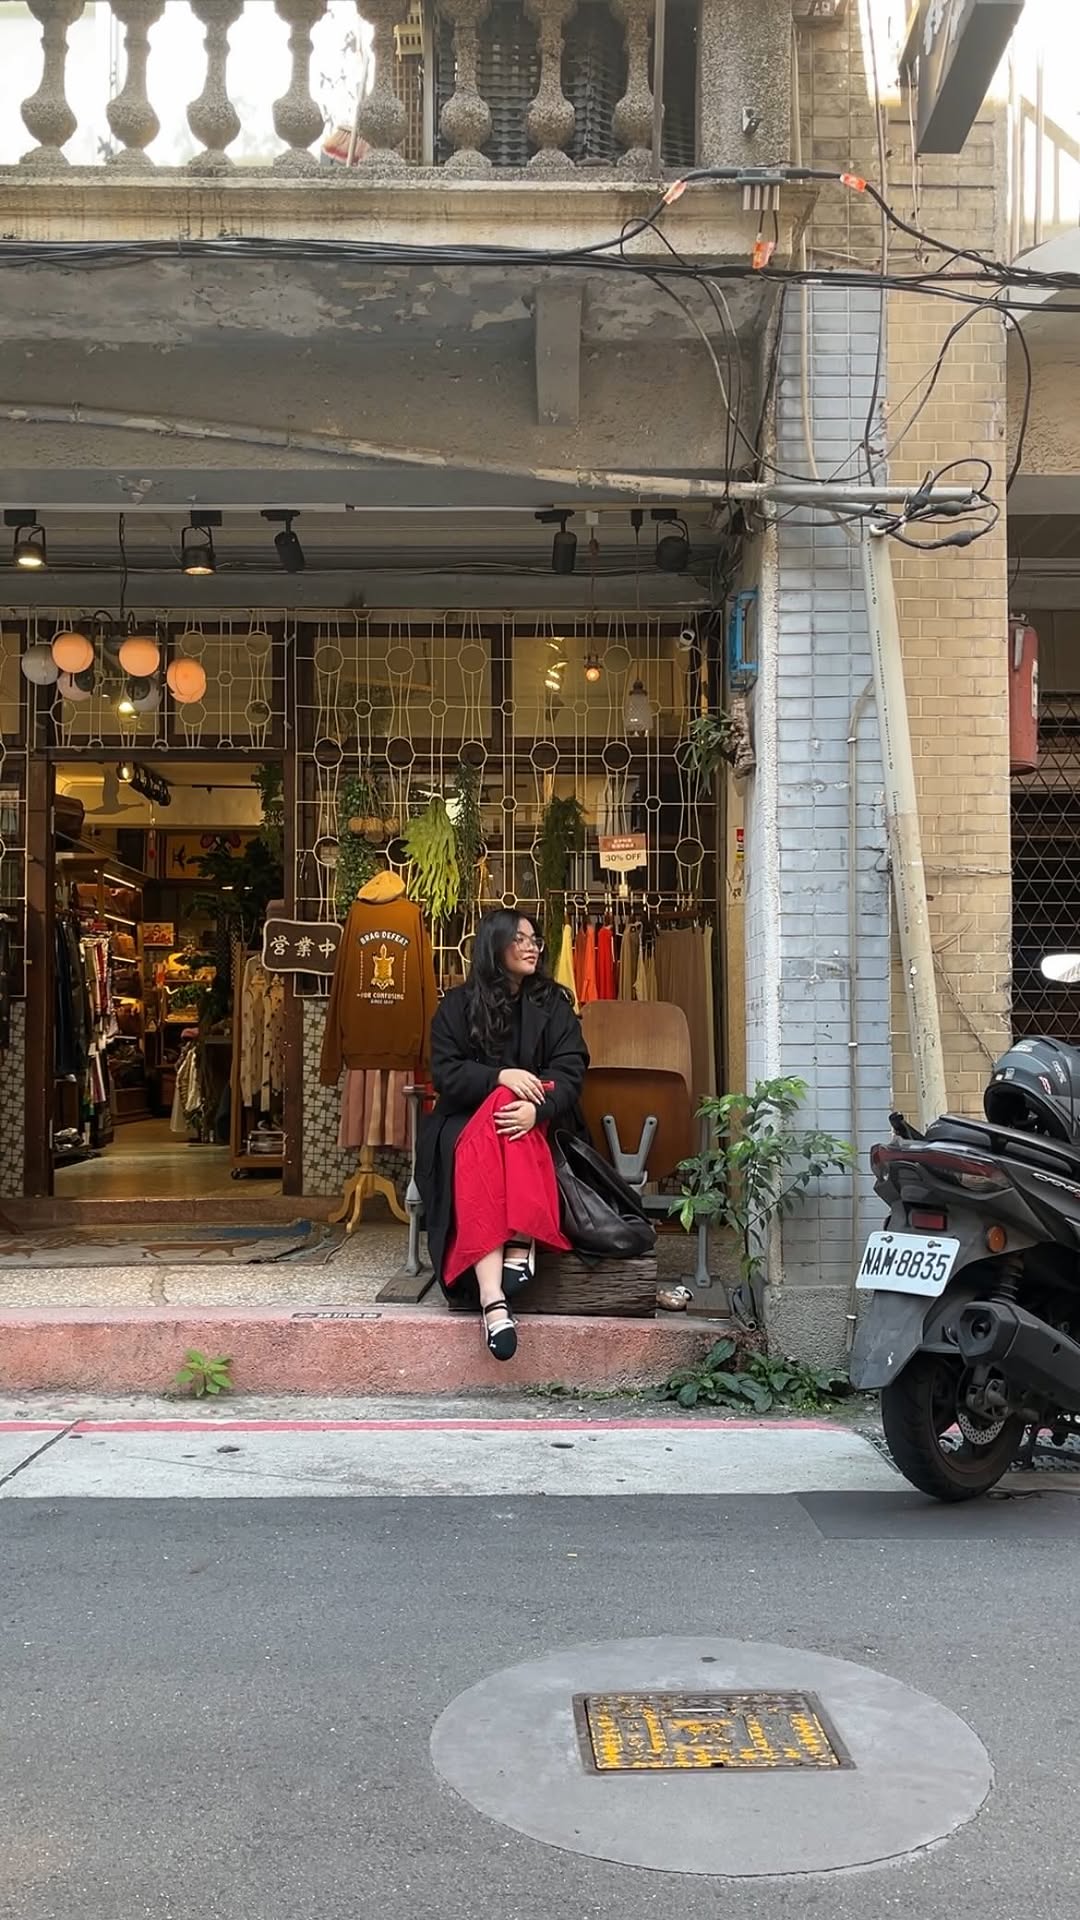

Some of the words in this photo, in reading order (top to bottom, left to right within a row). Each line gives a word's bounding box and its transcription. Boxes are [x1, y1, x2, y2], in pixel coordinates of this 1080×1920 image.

[605, 854, 624, 862] 30%
[625, 853, 641, 861] OFF
[381, 931, 409, 946] DEFEAT
